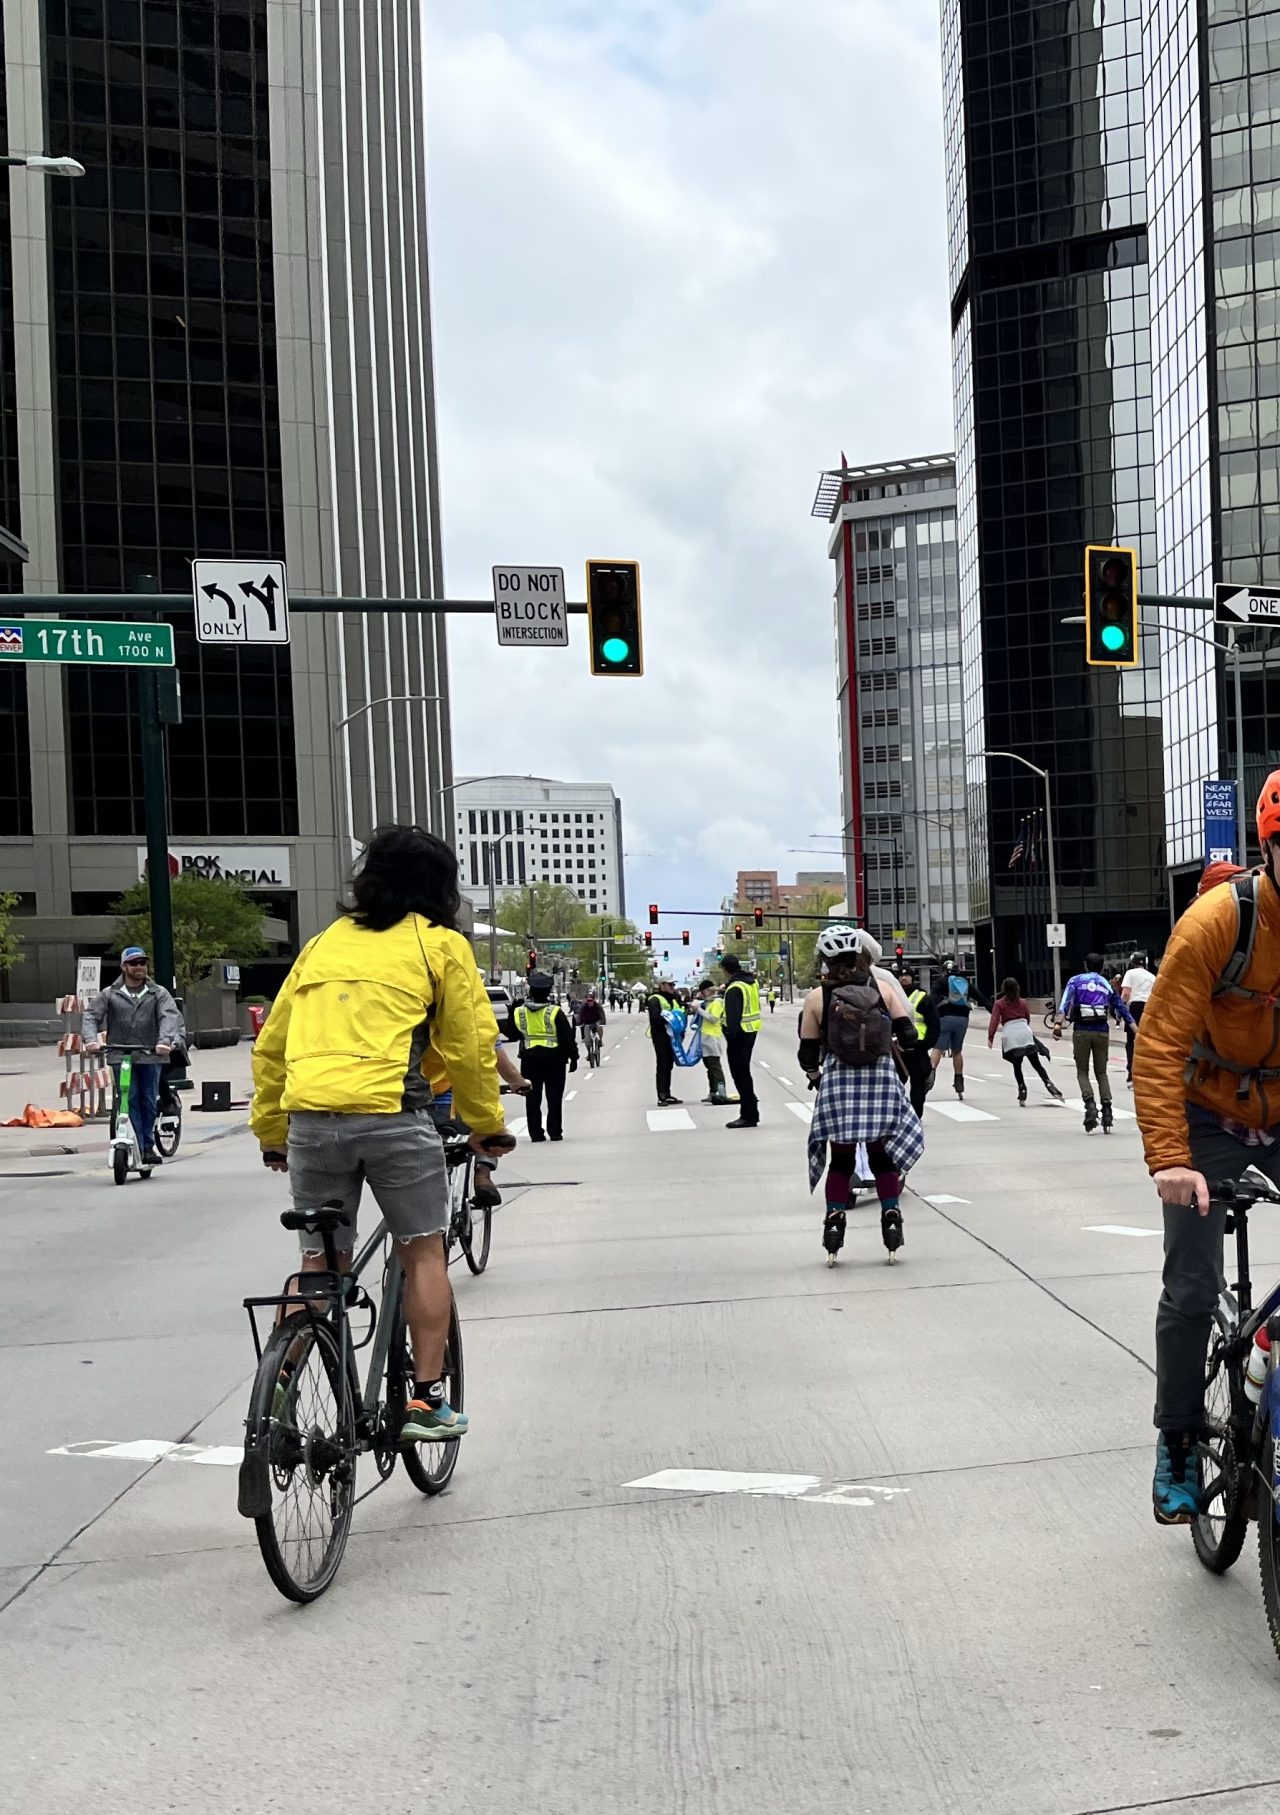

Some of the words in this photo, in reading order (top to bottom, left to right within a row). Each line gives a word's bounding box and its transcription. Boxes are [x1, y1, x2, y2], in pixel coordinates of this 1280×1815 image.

[498, 573, 520, 591] DO
[527, 574, 558, 592] NOT
[500, 602, 561, 620] BLOCK
[1249, 598, 1278, 614] ONE
[202, 622, 242, 635] ONLY
[502, 626, 563, 639] INTERSECTION
[0, 643, 22, 651] ENVER
[37, 628, 104, 656] 17th
[128, 631, 152, 642] Ave
[118, 645, 149, 657] 1700
[155, 646, 164, 657] N
[1205, 784, 1232, 792] NEAR
[1205, 792, 1231, 800] EAST
[1213, 800, 1232, 808] FAR
[1206, 808, 1234, 816] WEST
[181, 855, 221, 870] BOK
[182, 869, 282, 884] NANCIAL
